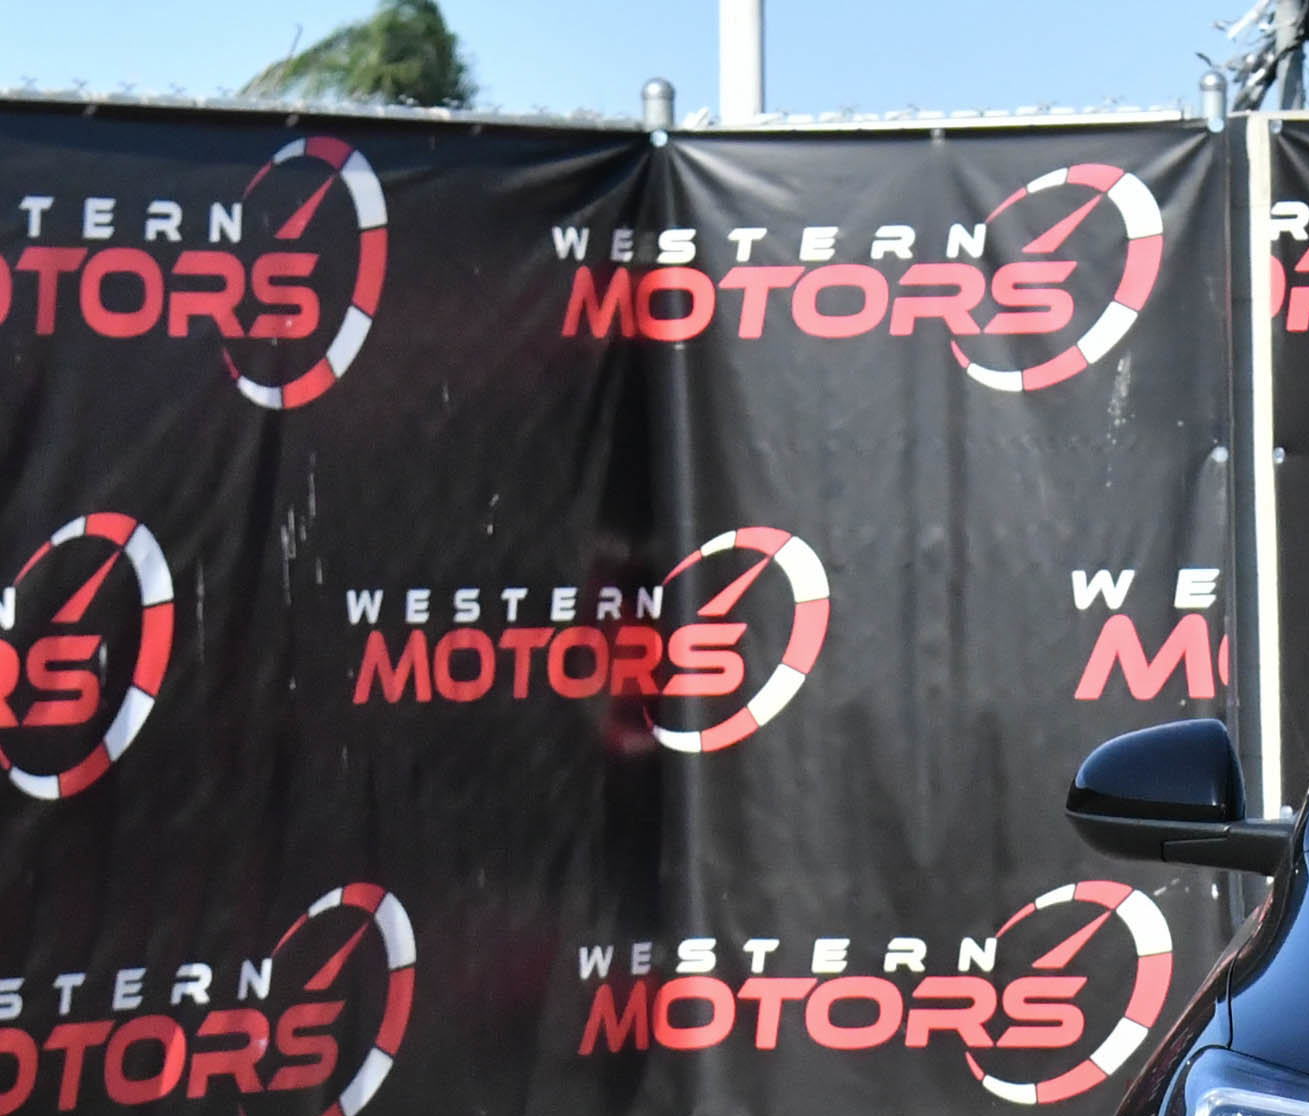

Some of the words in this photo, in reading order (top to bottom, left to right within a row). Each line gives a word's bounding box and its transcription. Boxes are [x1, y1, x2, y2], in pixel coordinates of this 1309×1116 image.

[552, 223, 987, 264] WESTERN
[0, 246, 320, 338] TORS
[561, 260, 1078, 342] MOTORS
[346, 586, 663, 625] WESTERN
[352, 622, 748, 705] MOTORS
[1073, 613, 1230, 700] M
[578, 936, 998, 980] WESTERN
[577, 975, 1089, 1056] MOTORS
